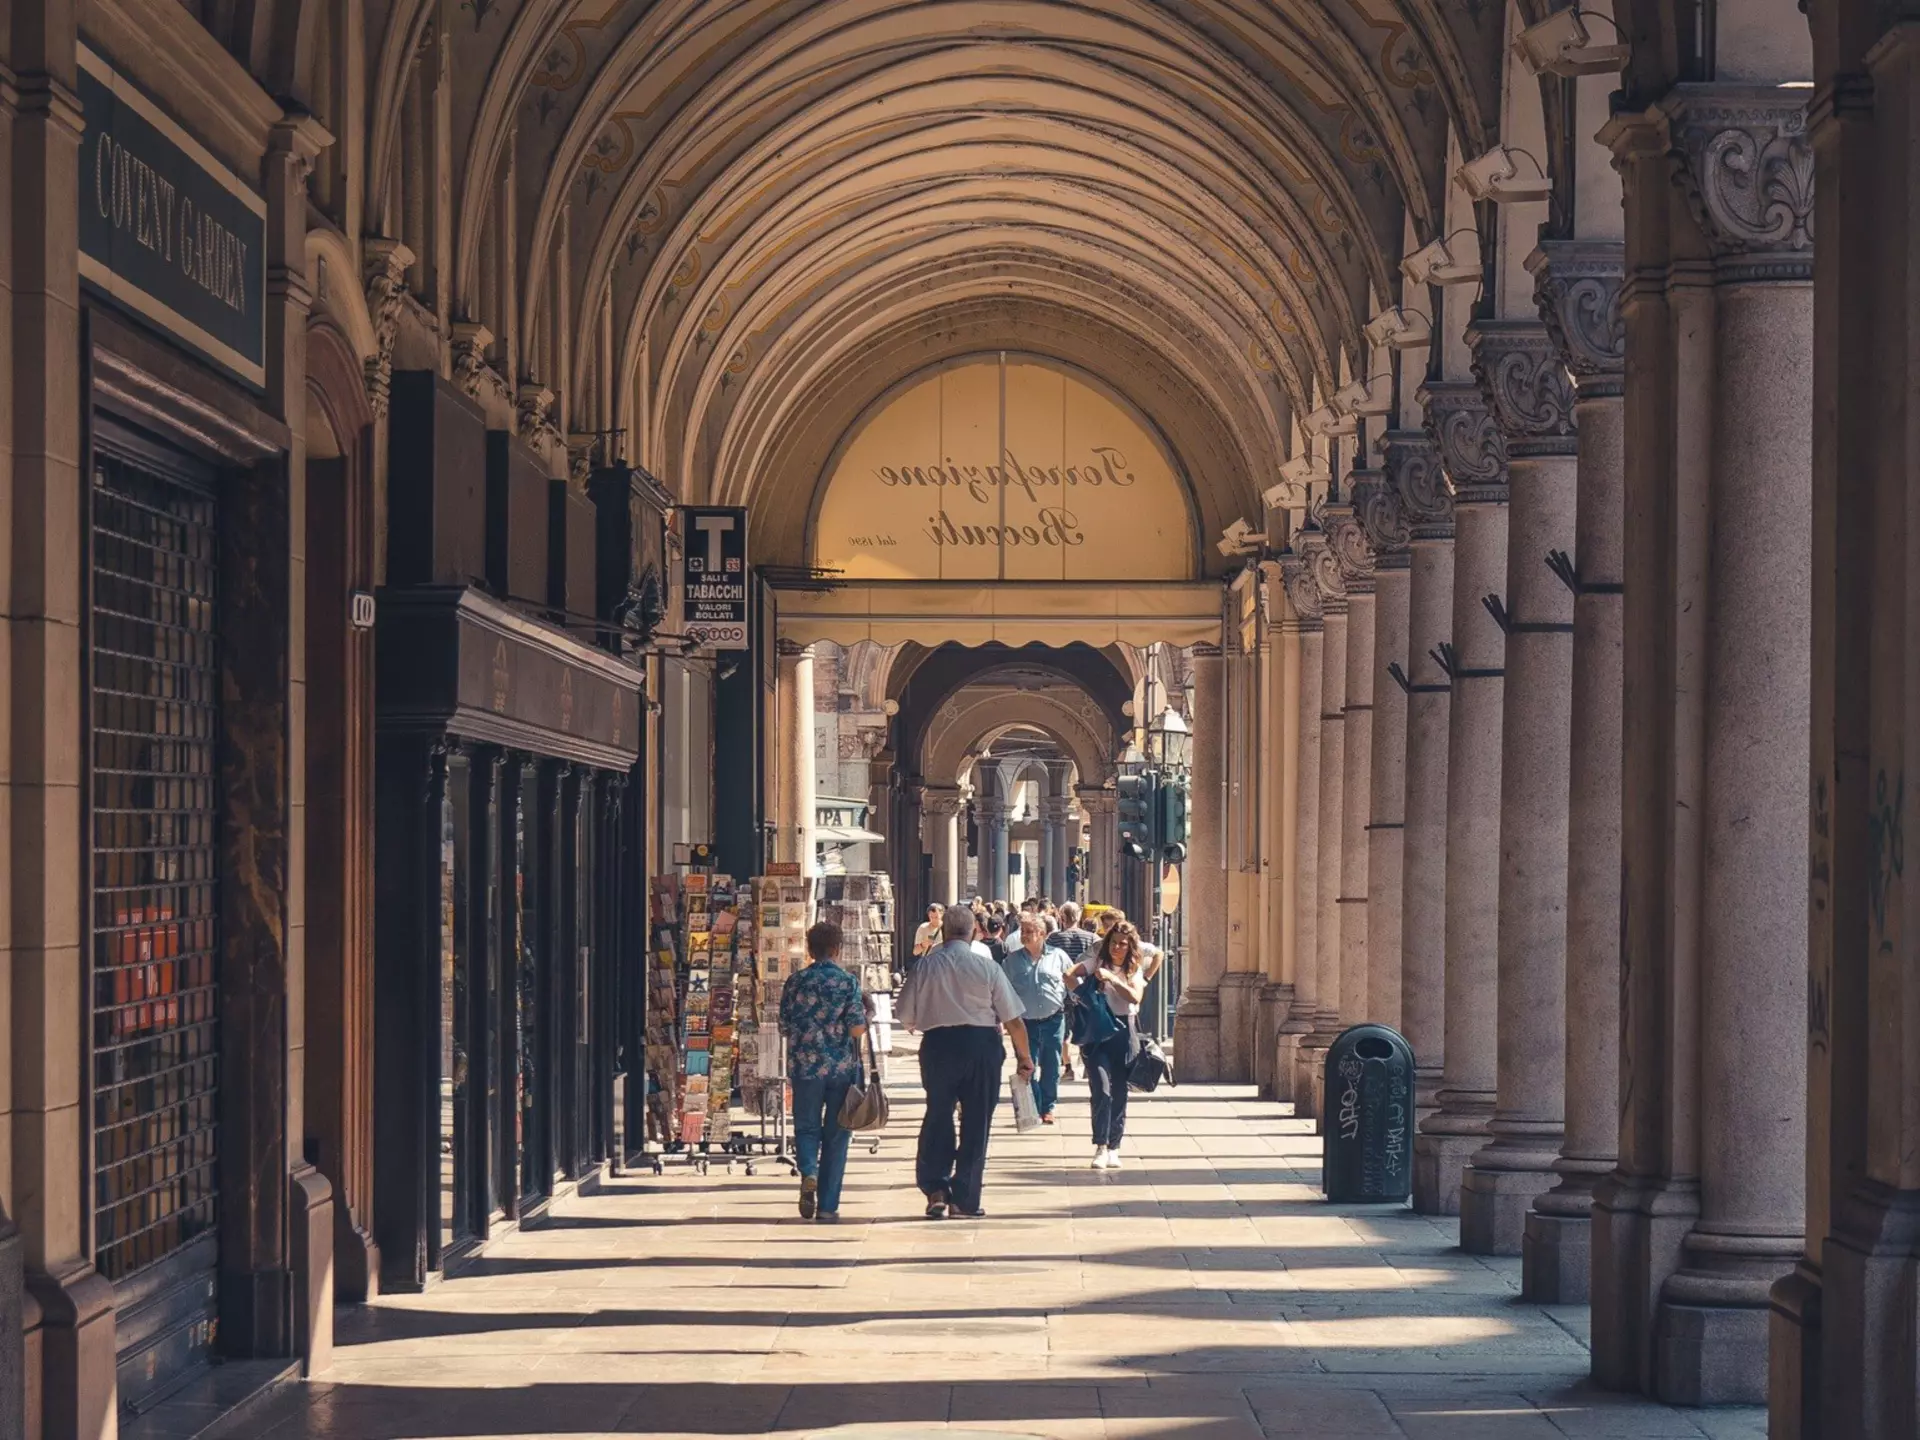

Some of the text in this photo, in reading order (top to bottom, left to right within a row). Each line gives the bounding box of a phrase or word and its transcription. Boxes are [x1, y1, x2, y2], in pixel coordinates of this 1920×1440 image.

[97, 132, 248, 317] COVENT GARDEN
[695, 516, 735, 572] T
[701, 574, 729, 582] SALI E
[686, 584, 743, 599] TABACCHI
[356, 597, 372, 623] 10
[698, 603, 732, 611] VALORI
